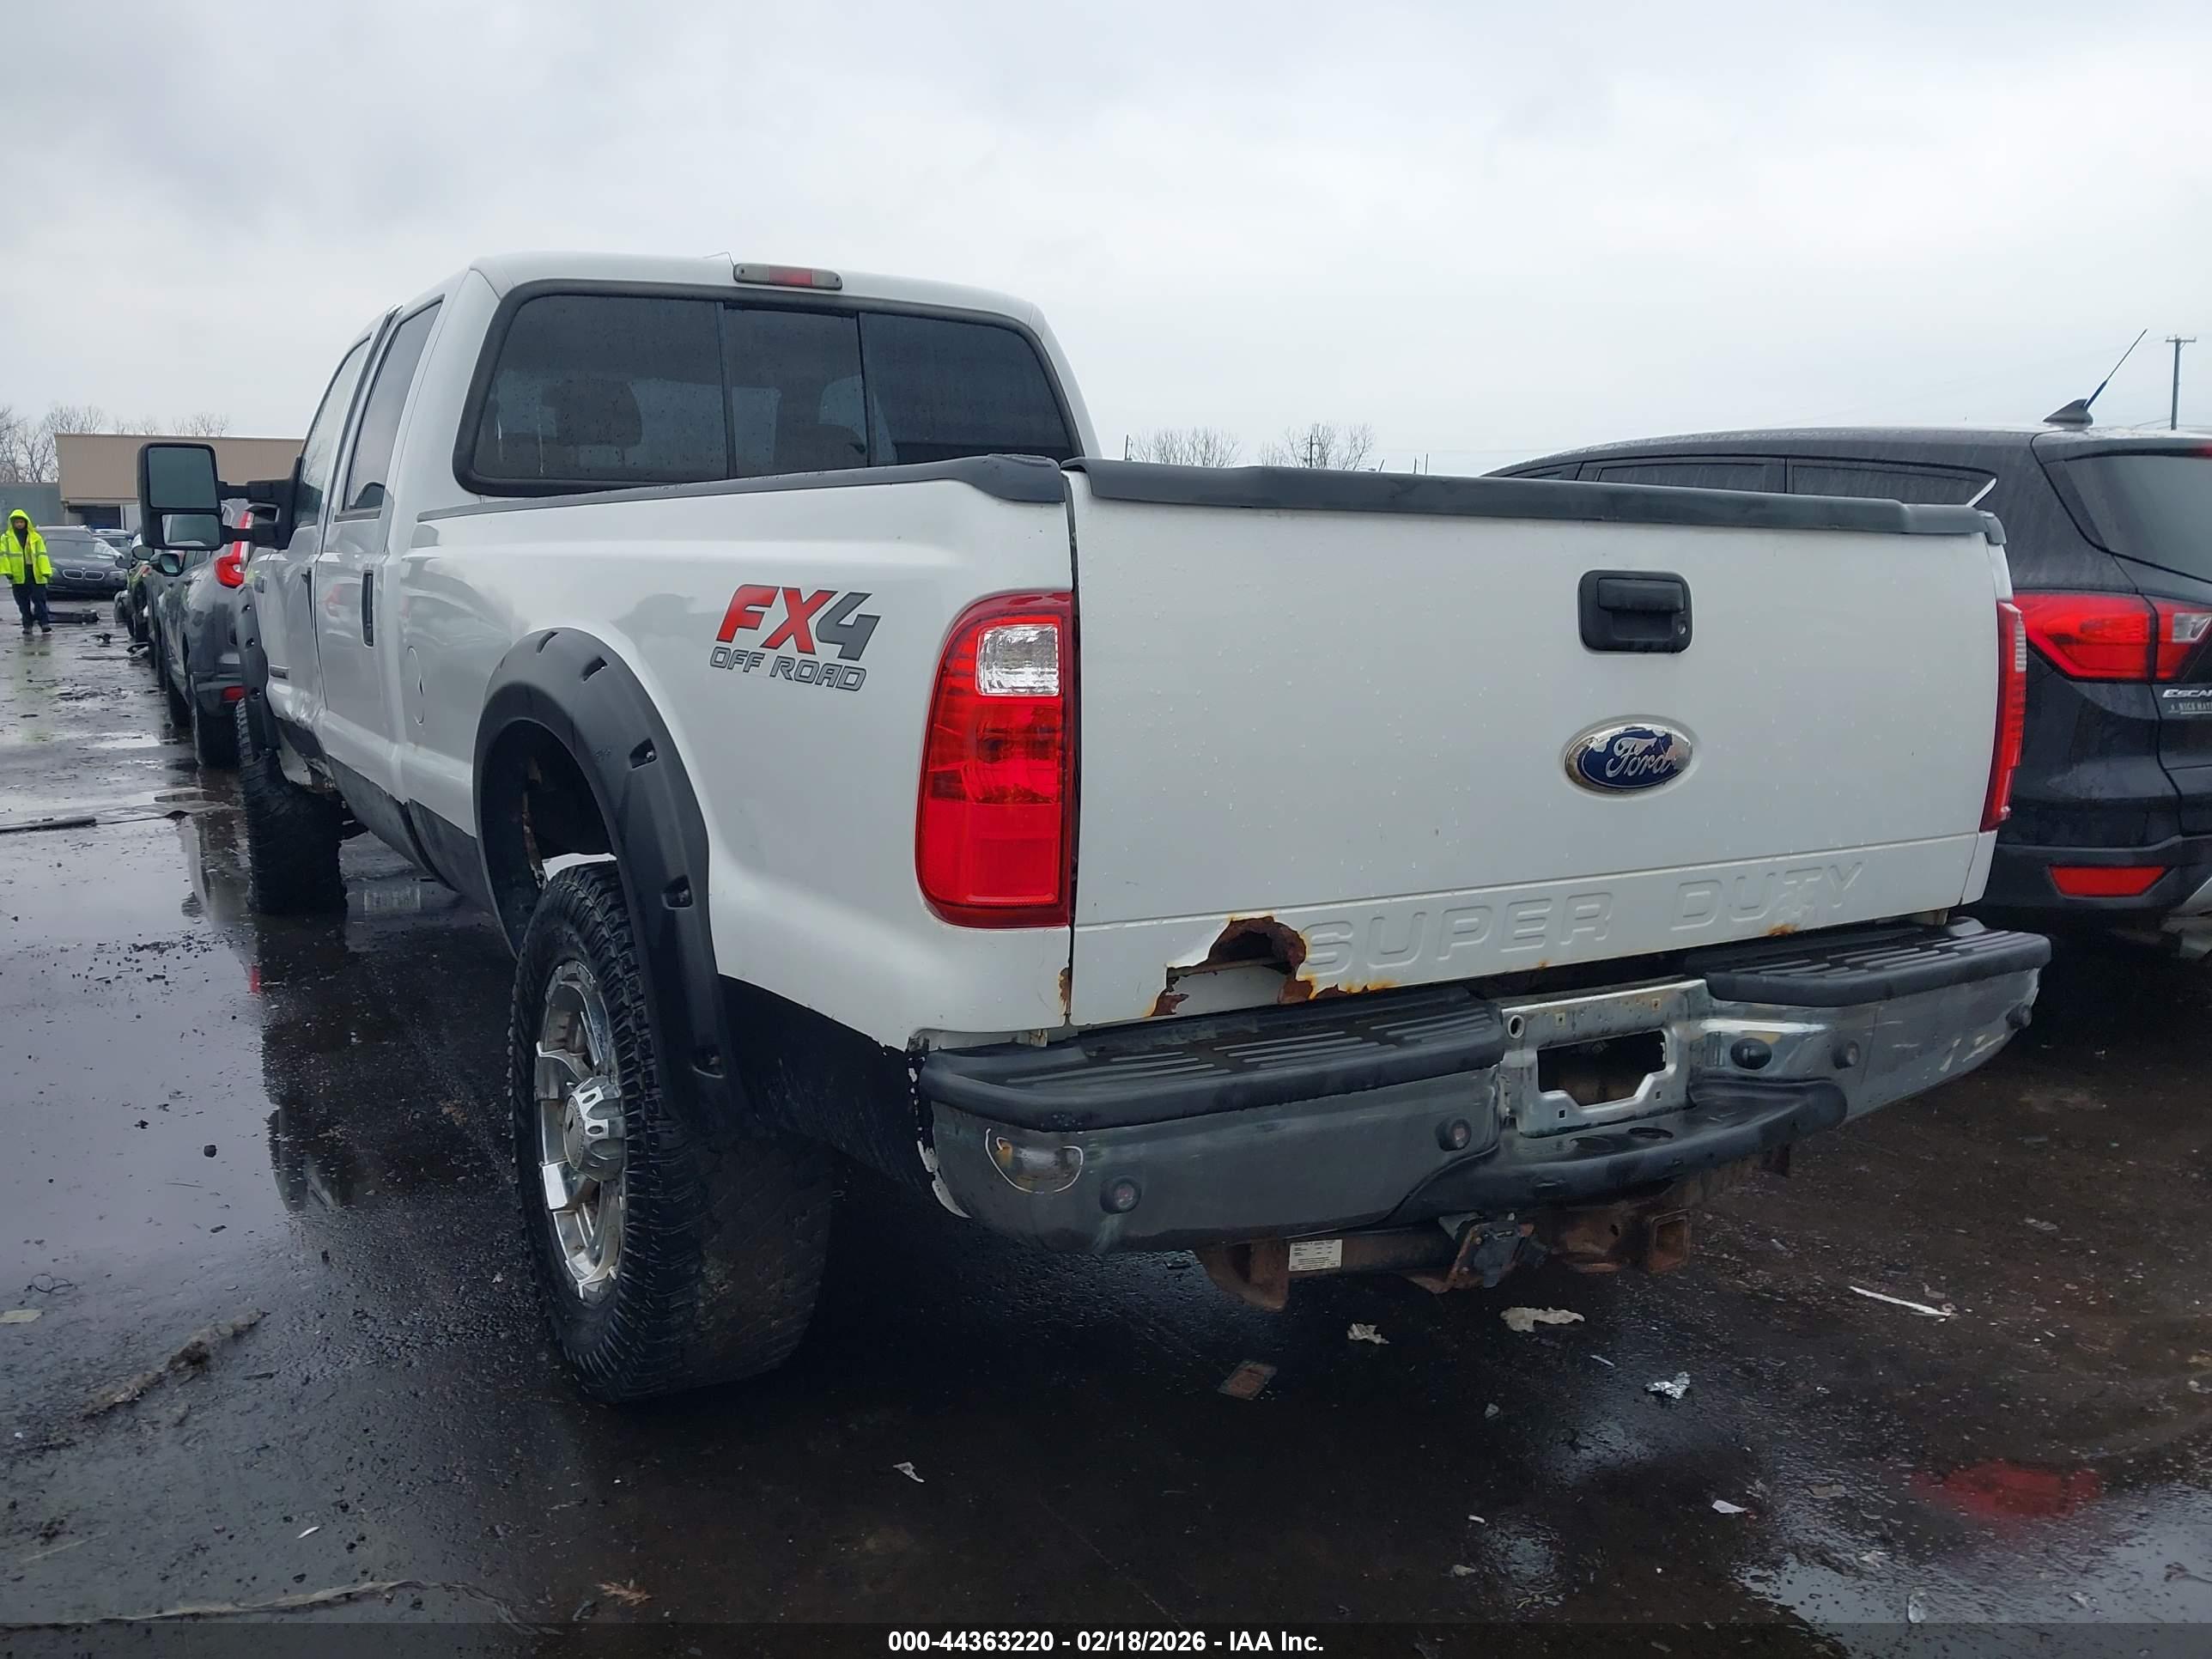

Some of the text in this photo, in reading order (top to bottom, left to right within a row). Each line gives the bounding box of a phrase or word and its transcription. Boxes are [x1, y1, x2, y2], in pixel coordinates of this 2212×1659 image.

[715, 583, 882, 662] FX4
[709, 646, 867, 692] OFF ROAD
[1605, 737, 1673, 778] Ford
[1298, 860, 1864, 978] SUPER DUTY
